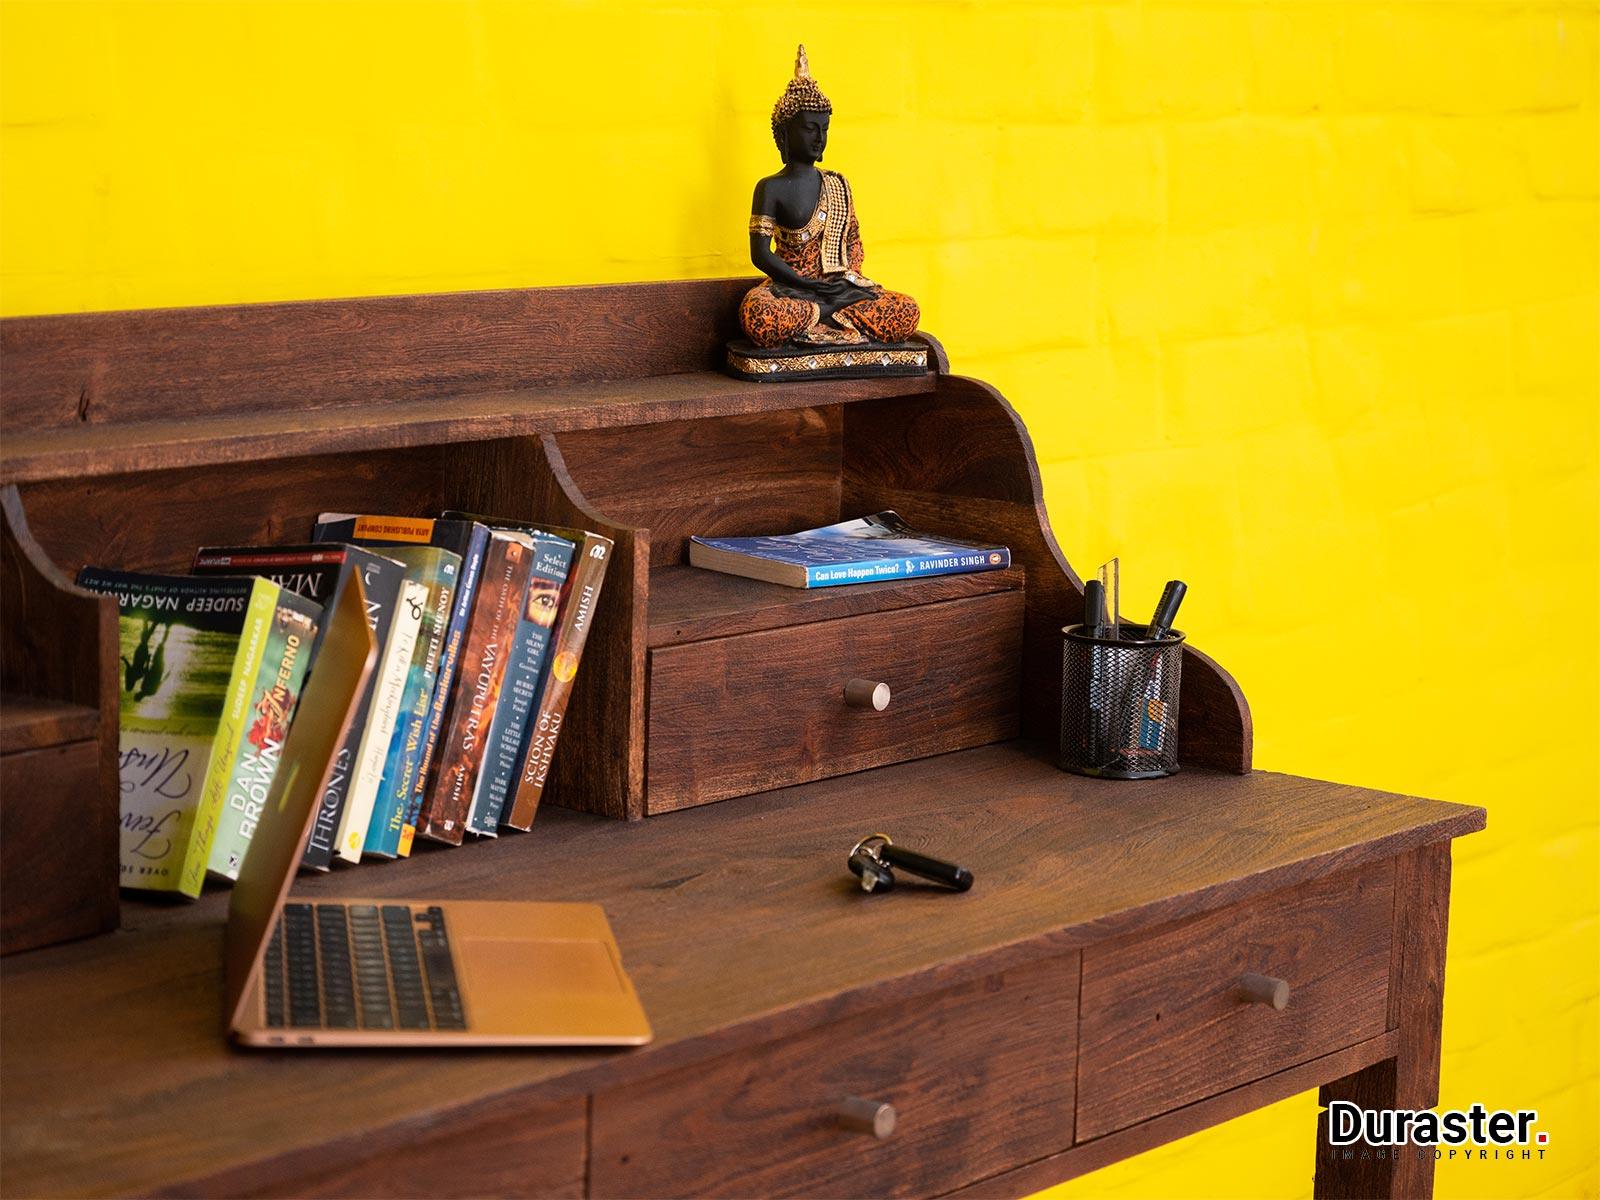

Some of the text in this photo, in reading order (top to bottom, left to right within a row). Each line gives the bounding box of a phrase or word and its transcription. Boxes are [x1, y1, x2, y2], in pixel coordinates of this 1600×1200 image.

[384, 526, 415, 536] PUBLISHING
[536, 554, 567, 579] Select Editions
[186, 596, 245, 612] SUDEEP
[271, 572, 323, 597] MA
[816, 555, 985, 581] Can Love Happen Twice? RAVINDER SINGH
[423, 587, 450, 679] PREETI SHENOY
[574, 585, 594, 632] AMISH
[232, 618, 263, 720] SUDEEP NAGARKAR
[264, 634, 300, 721] INFERNO
[433, 629, 461, 712] Baskervilles
[463, 643, 498, 751] VAYUPUTRAS
[230, 752, 259, 812] DAN
[389, 802, 404, 832] The
[397, 757, 414, 800] Secret
[406, 719, 422, 752] Wish
[453, 765, 466, 801] AMISH
[525, 711, 553, 784] SCION OF
[534, 713, 562, 789] IKSHVAKU
[239, 737, 282, 840] BROWN
[307, 748, 350, 853] THRONES
[140, 865, 169, 876] OVER
